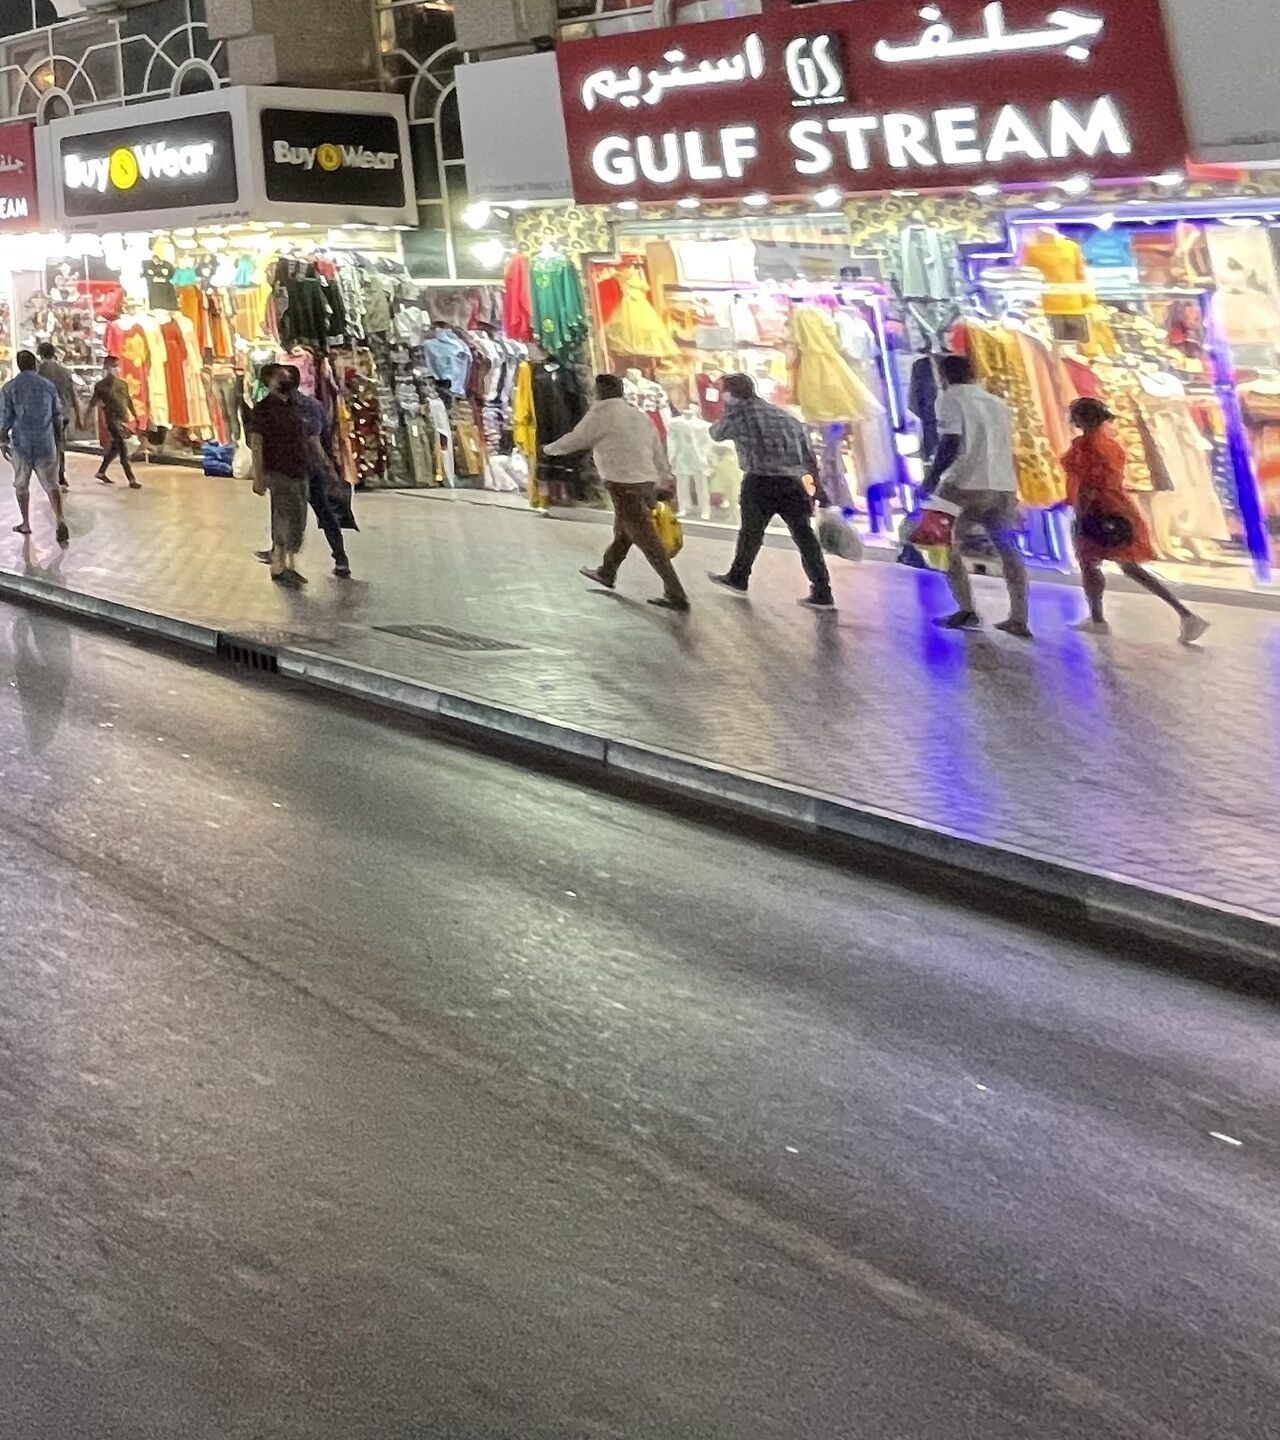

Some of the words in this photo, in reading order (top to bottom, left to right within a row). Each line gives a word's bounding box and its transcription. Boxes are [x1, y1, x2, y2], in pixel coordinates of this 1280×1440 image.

[873, 3, 1105, 64] جلف
[583, 35, 765, 111] استريم
[591, 126, 758, 186] GULF
[790, 95, 1131, 175] STREAM
